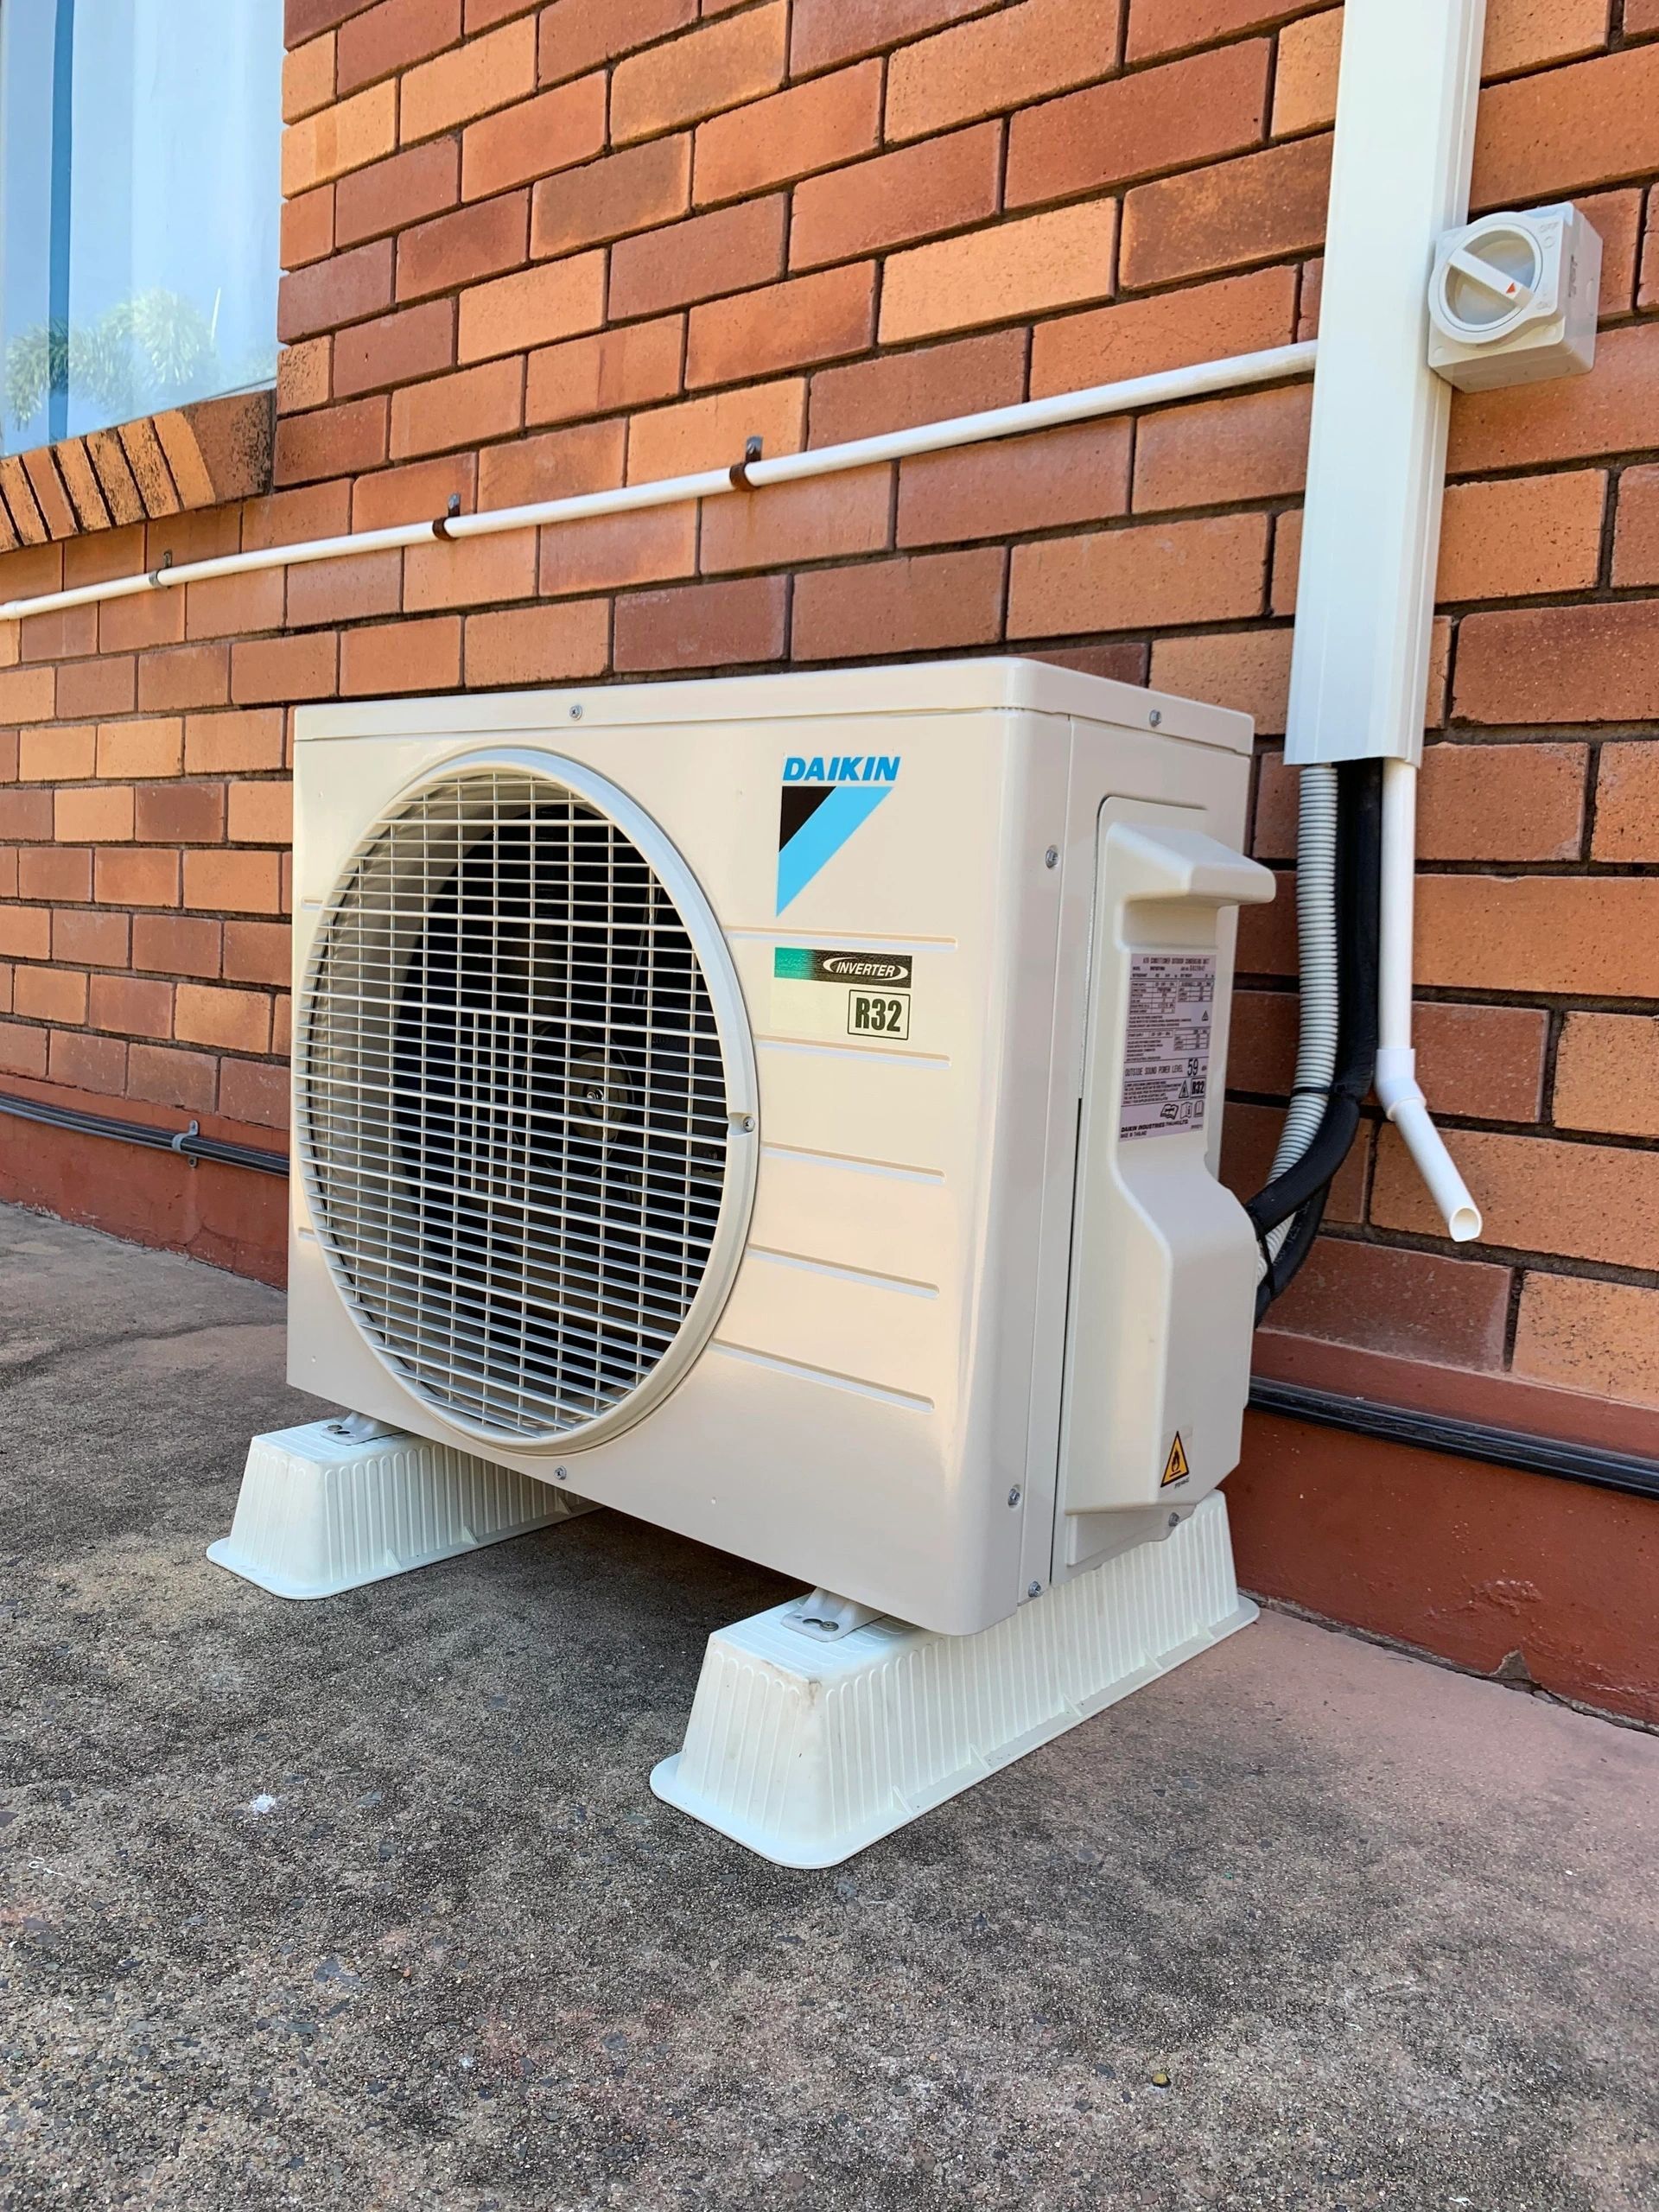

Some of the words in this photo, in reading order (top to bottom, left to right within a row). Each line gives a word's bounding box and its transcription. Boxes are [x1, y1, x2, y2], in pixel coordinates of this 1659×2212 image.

[782, 756, 901, 781] DAIKIN
[835, 961, 895, 977] INVERTER
[855, 997, 902, 1033] R32
[1125, 1067, 1142, 1077] OUTSIDE
[1145, 1066, 1157, 1075] SOUND
[1159, 1065, 1171, 1074] POWER
[1172, 1065, 1183, 1073] LEVEL
[1187, 1058, 1198, 1076] 59
[1192, 1081, 1205, 1095] R32
[1138, 1122, 1165, 1131] INDUSTRIES
